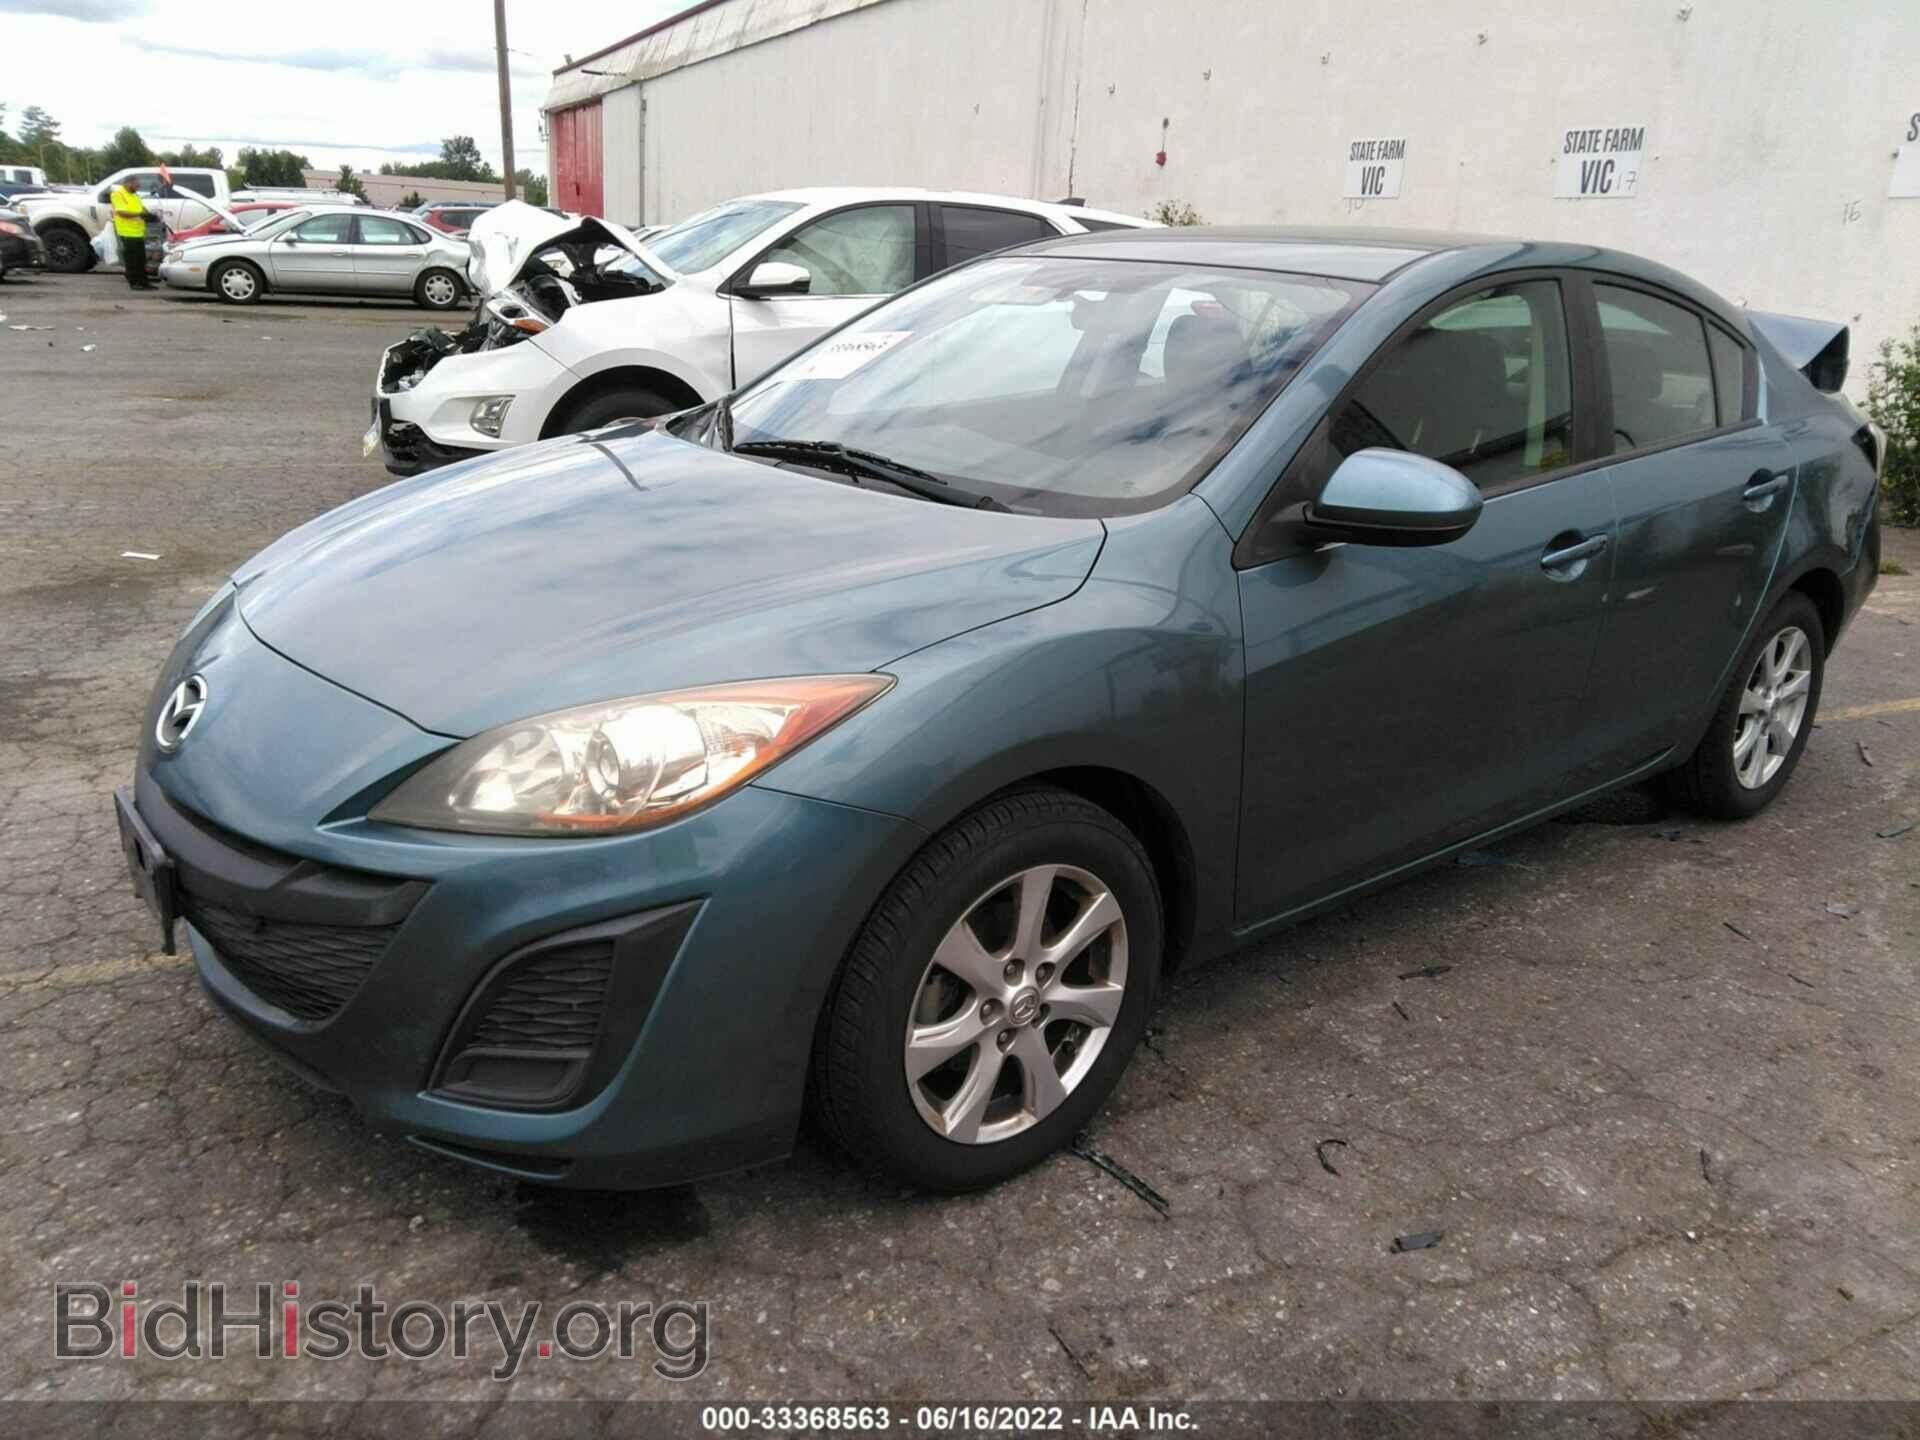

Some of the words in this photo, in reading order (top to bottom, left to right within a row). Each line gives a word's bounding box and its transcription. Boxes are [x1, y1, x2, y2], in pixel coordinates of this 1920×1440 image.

[1350, 141, 1377, 161] STATE
[1376, 139, 1406, 160] FARM
[1563, 129, 1602, 154] STATE
[1603, 127, 1645, 153] FARM
[1361, 166, 1386, 195] VIC
[1580, 159, 1615, 194] VIC
[1616, 170, 1637, 191] 17
